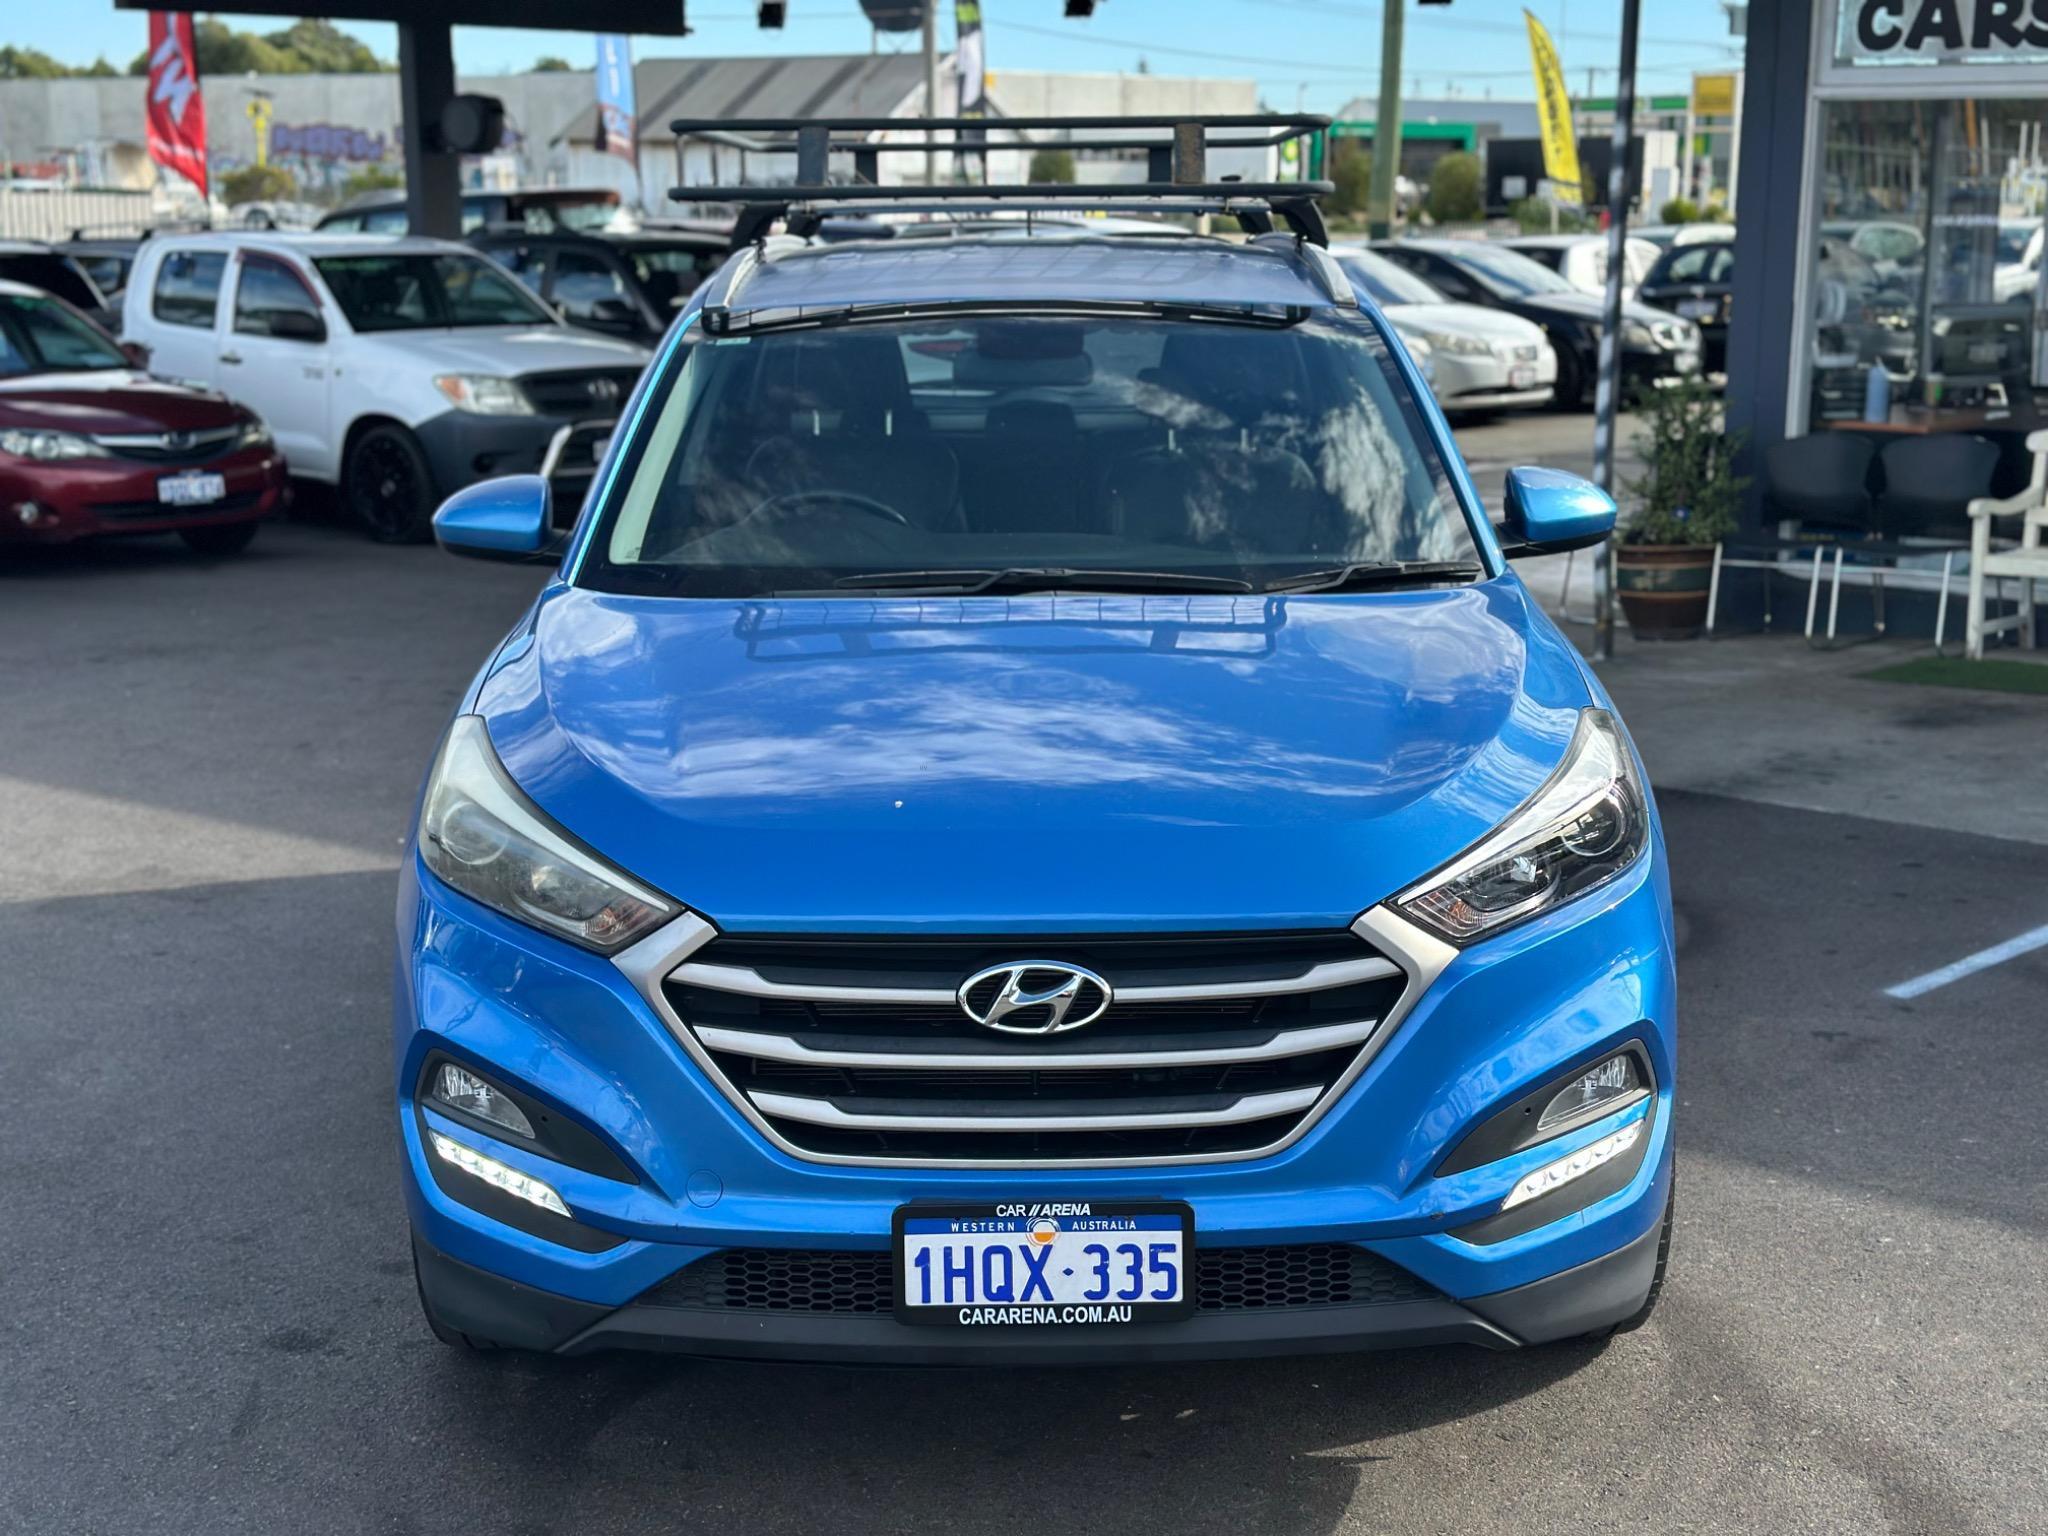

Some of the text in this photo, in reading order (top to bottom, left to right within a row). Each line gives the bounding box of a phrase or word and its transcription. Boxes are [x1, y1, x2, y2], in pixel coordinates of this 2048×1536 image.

[951, 1219, 1137, 1233] WESTERN AUSTRALIA
[959, 1305, 1132, 1325] CARARENA.COM.AU
